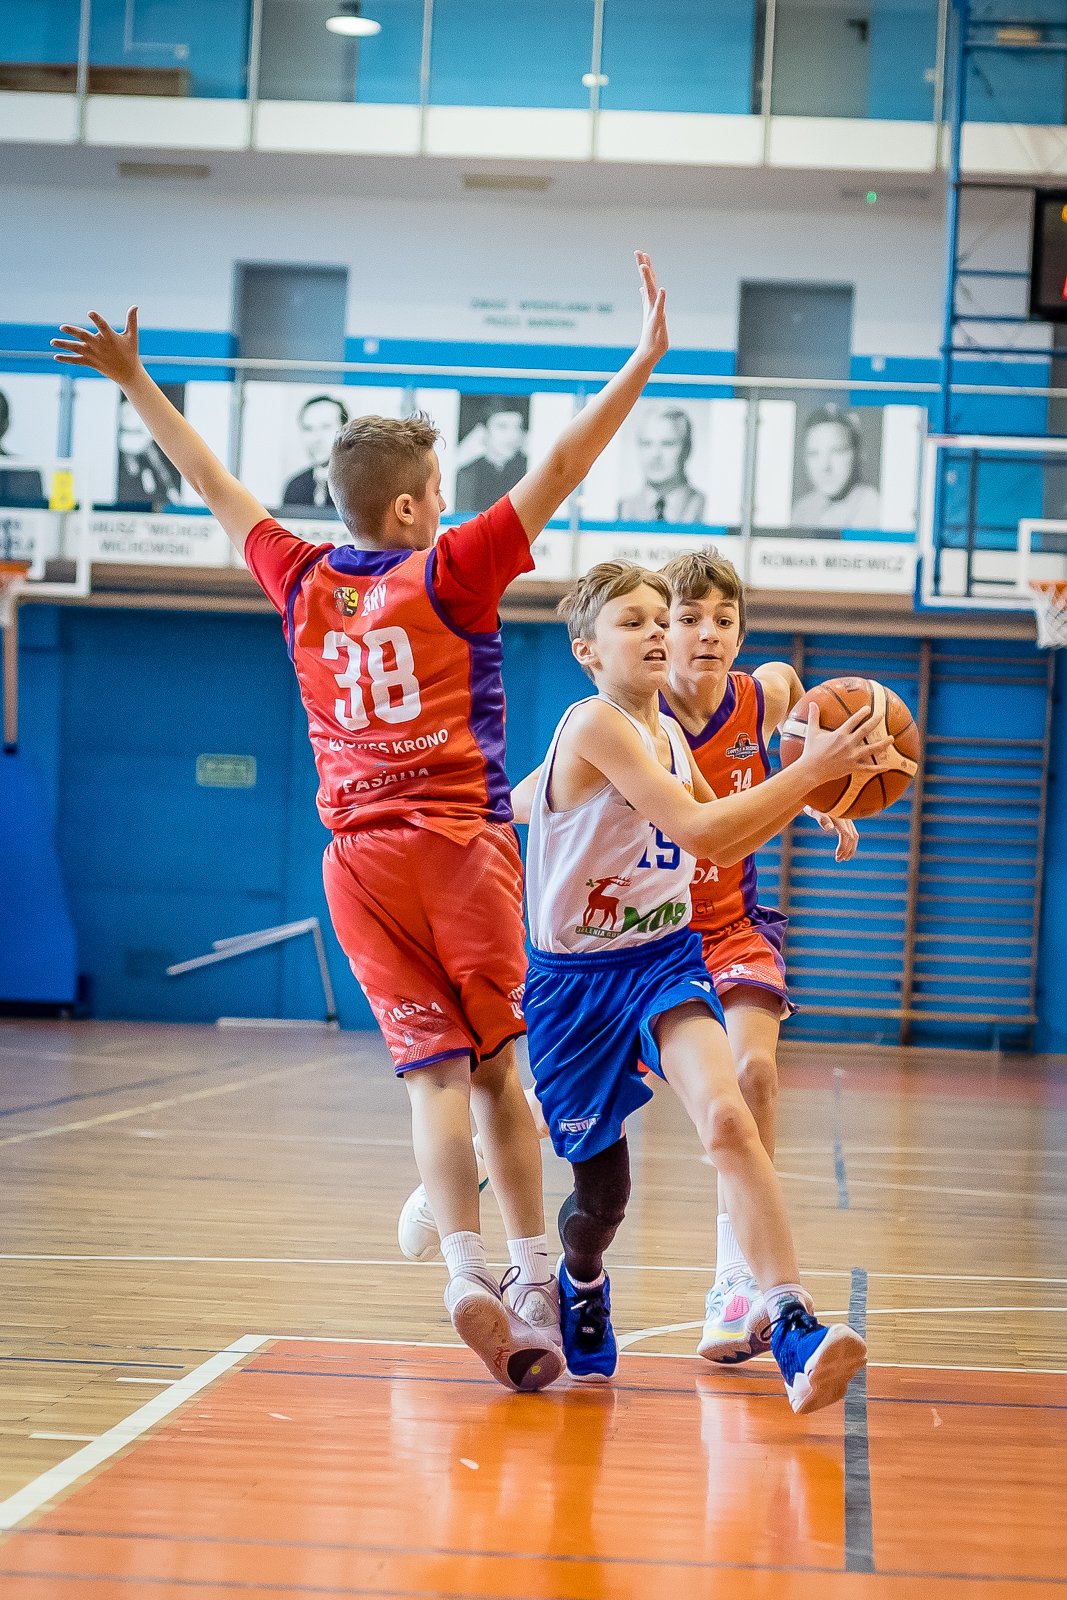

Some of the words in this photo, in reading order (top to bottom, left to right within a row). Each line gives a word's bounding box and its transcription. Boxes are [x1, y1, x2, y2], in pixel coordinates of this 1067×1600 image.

[322, 626, 422, 731] 38
[392, 728, 449, 755] KRONO
[729, 767, 752, 796] 34
[691, 865, 720, 885] DA
